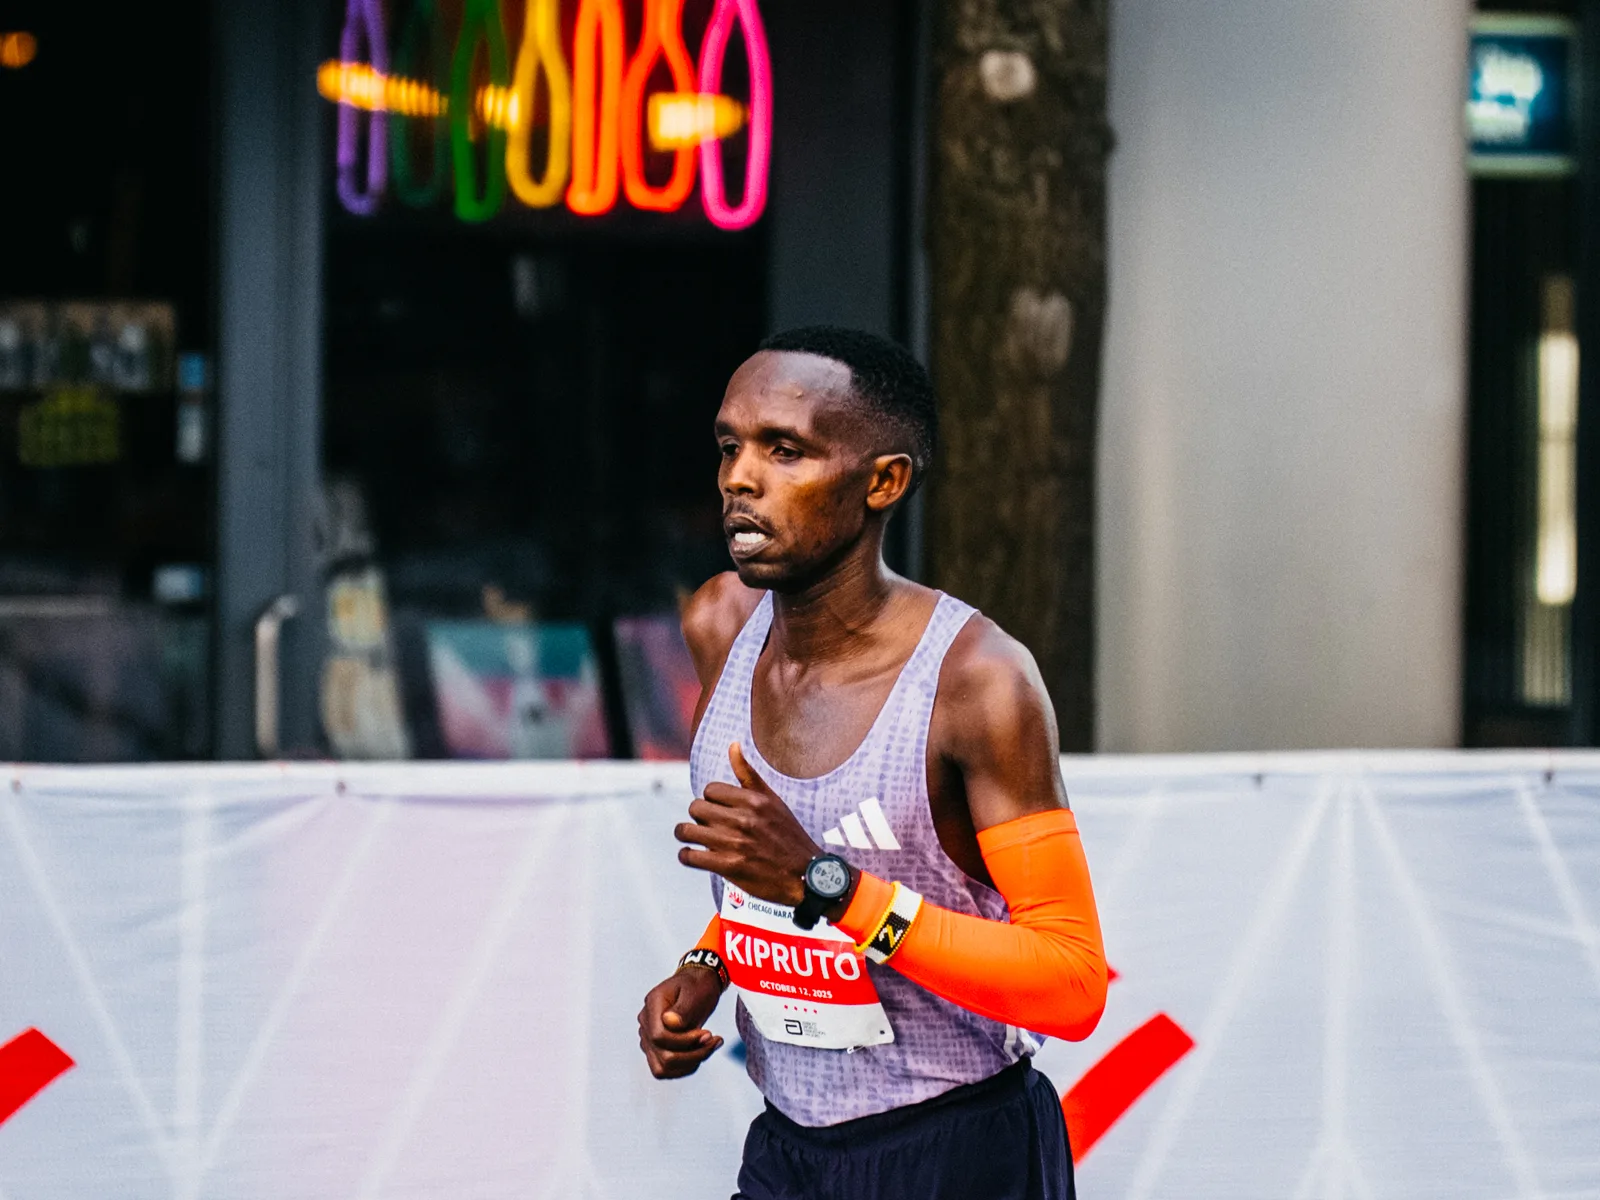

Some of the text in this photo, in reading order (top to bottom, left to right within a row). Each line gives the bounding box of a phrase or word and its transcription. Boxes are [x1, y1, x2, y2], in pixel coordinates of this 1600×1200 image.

[747, 901, 794, 920] CHICAGO MARA
[680, 950, 719, 967] AM
[725, 930, 861, 981] KIPRUTO
[760, 980, 797, 994] OCTOBER
[812, 989, 833, 999] 2025
